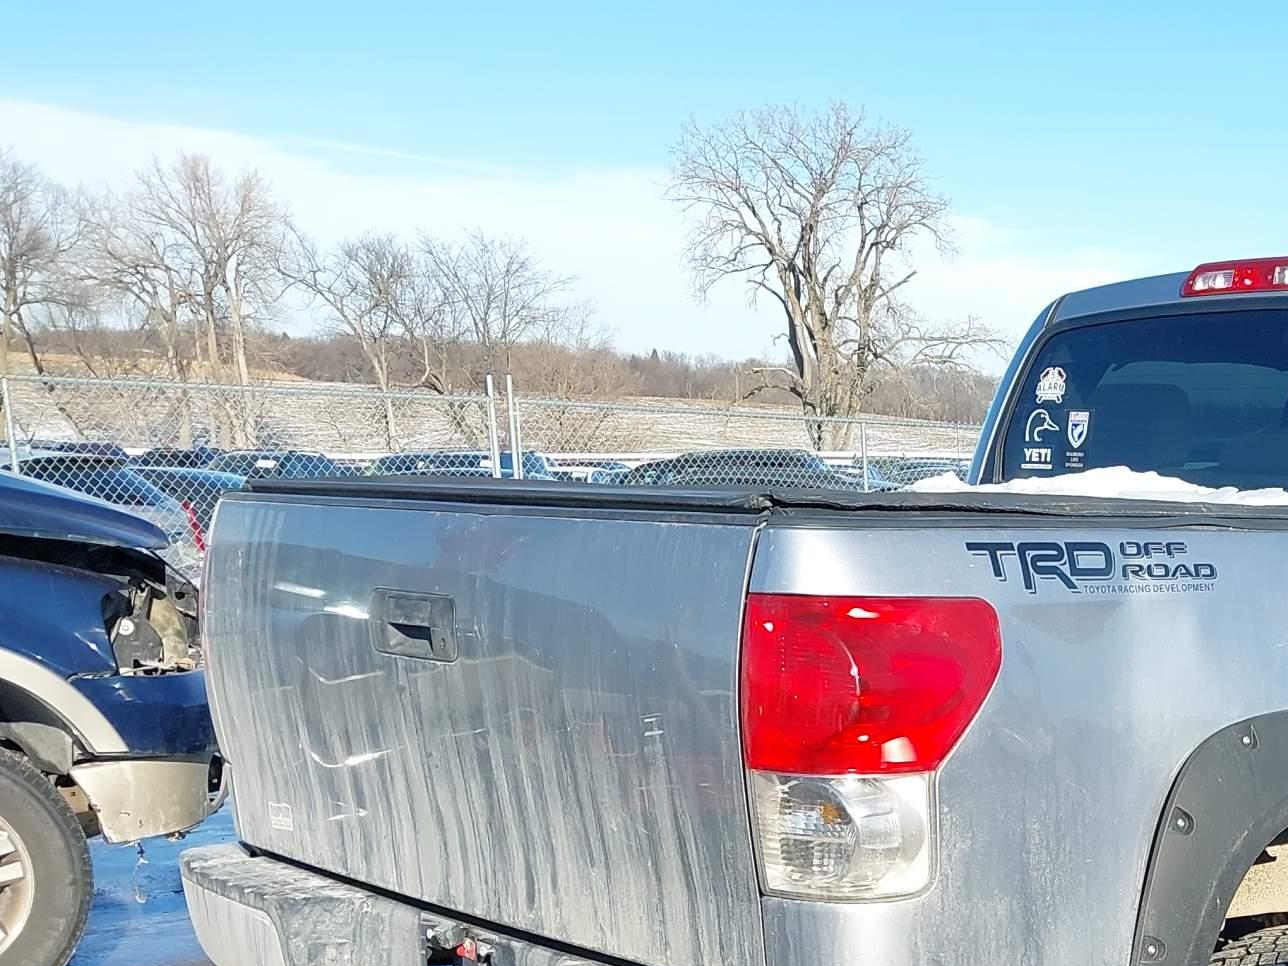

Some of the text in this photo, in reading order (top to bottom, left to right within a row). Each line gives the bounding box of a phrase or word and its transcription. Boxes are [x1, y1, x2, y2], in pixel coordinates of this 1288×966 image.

[1023, 448, 1052, 462] YETI
[965, 541, 1188, 594] TRD OFF
[1121, 563, 1217, 581] ROAD
[1084, 583, 1215, 594] TOYOTA RACING DEVELOPMENT
